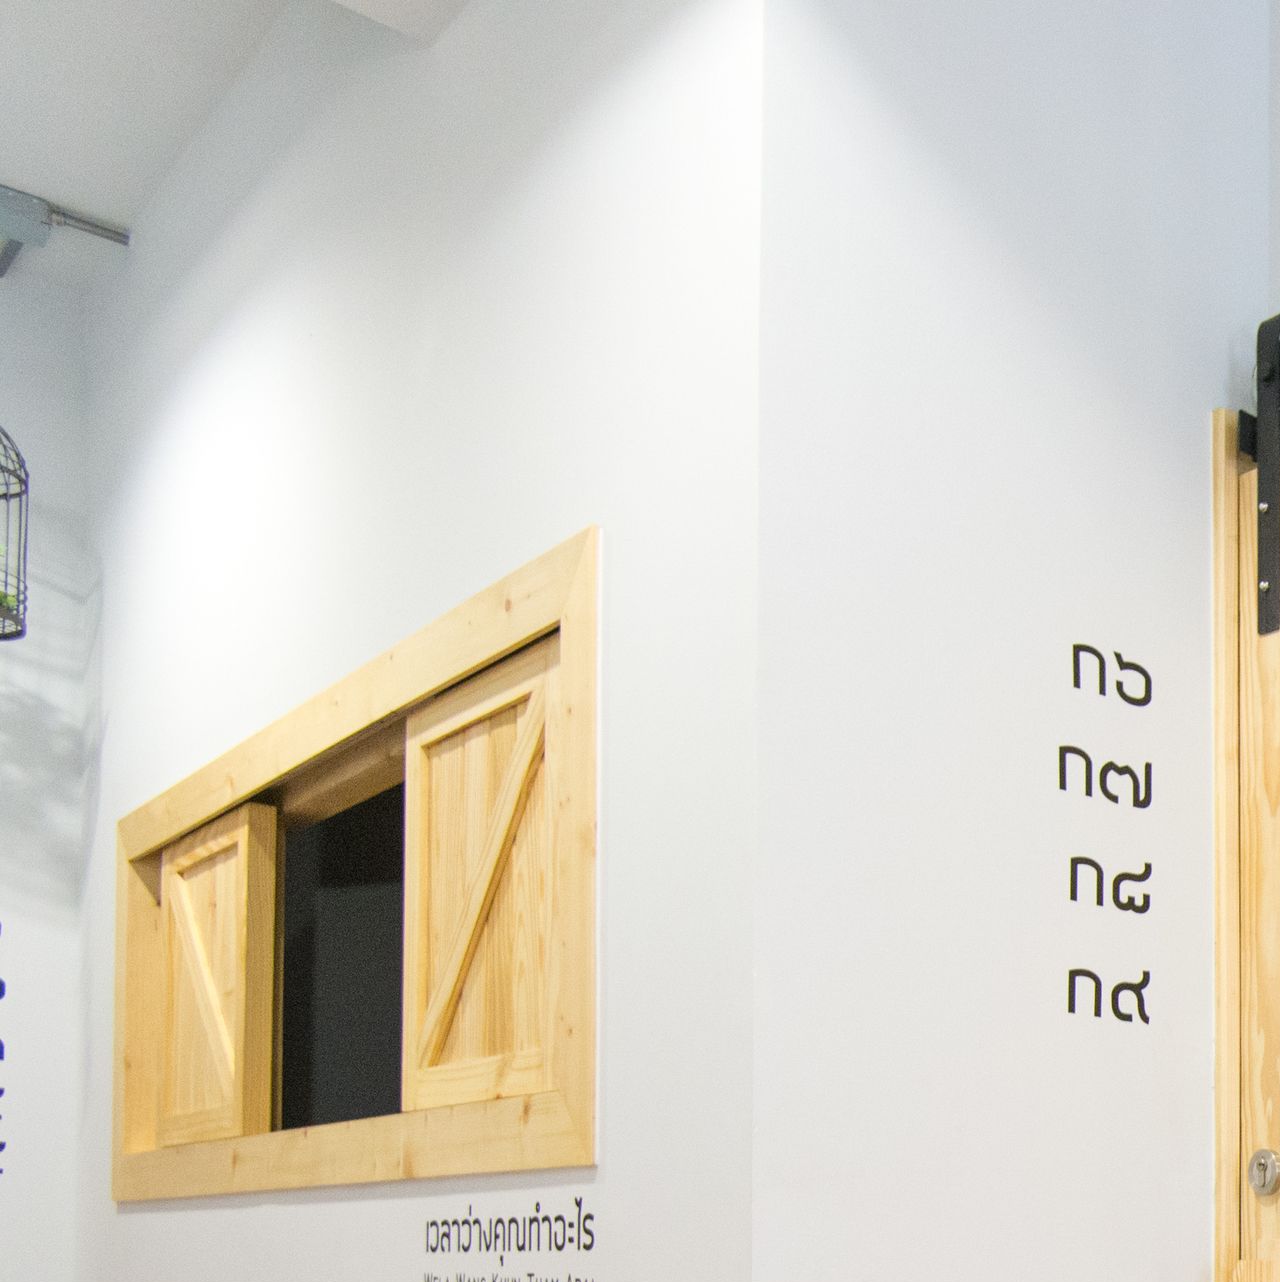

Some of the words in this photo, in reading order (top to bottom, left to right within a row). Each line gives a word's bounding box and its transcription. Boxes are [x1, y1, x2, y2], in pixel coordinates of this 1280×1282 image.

[426, 1197, 595, 1266] เวลาว่างคุณทำอะไร
